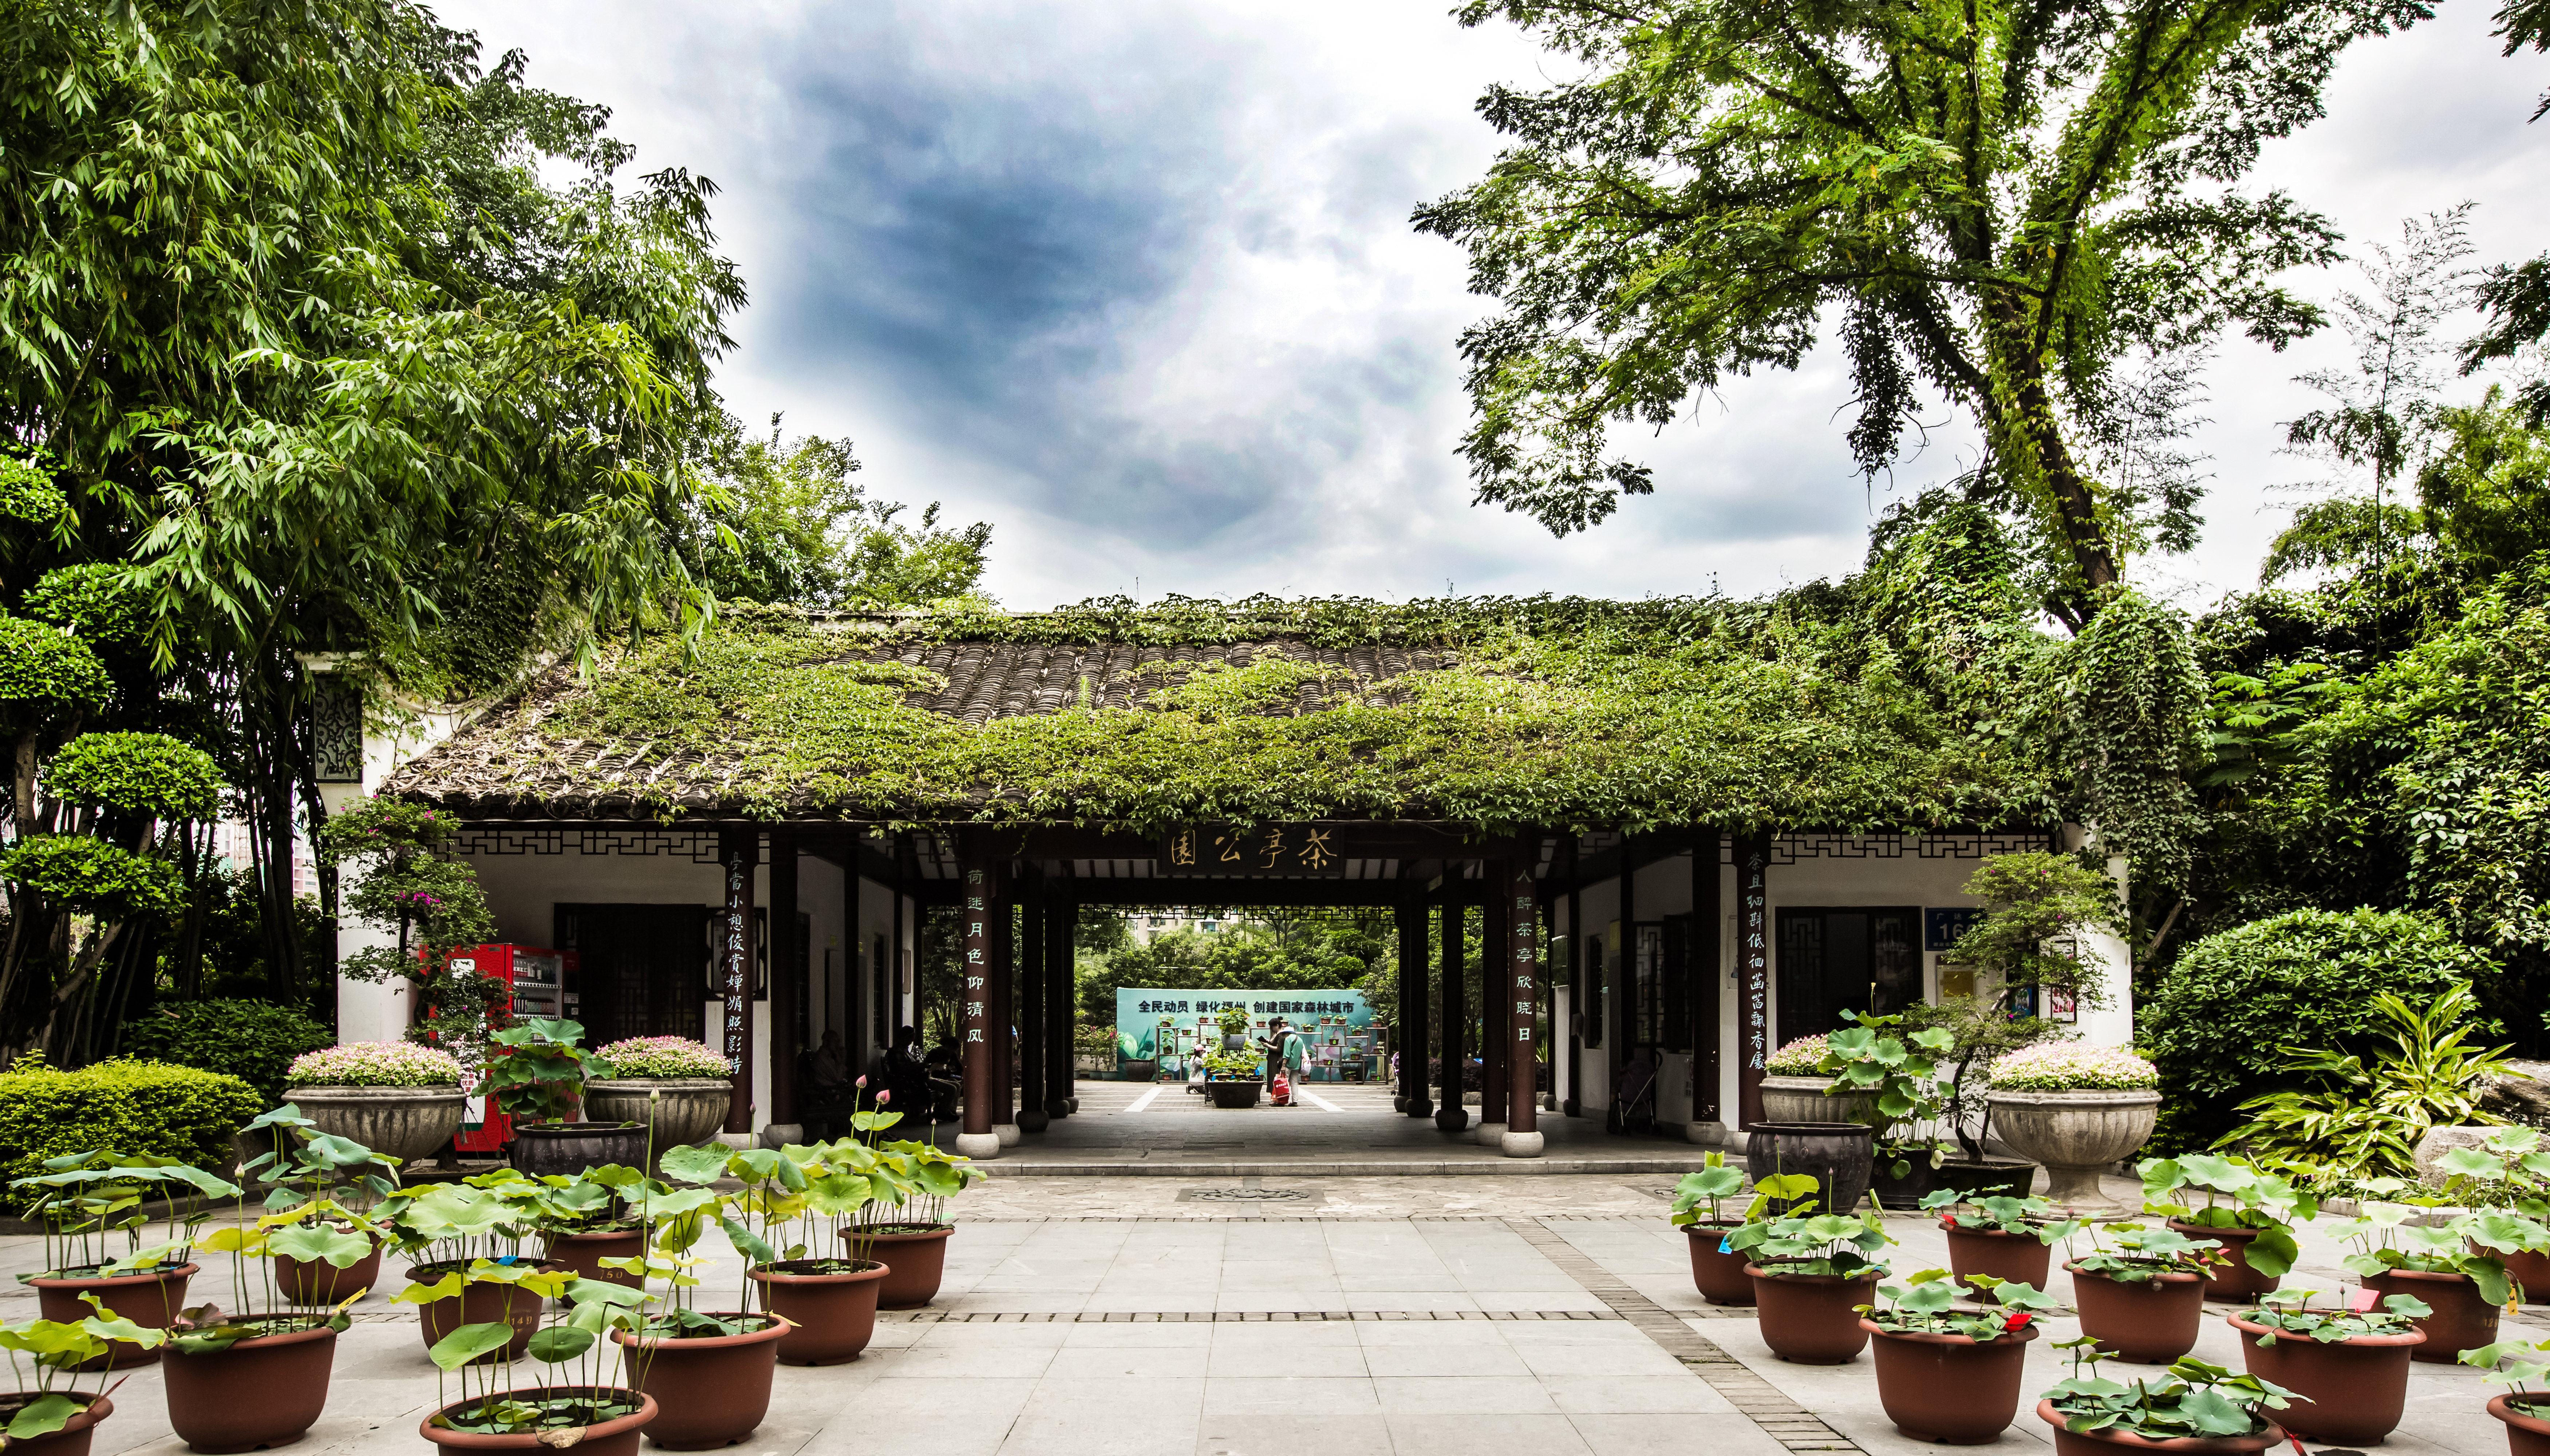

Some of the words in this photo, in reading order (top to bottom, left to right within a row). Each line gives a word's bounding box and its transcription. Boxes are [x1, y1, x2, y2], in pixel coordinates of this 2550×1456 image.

[1138, 1000, 1189, 1013] 全民动员
[1196, 1001, 1246, 1013] 绿化福州
[1253, 1001, 1354, 1013] 创建国家森林城市
